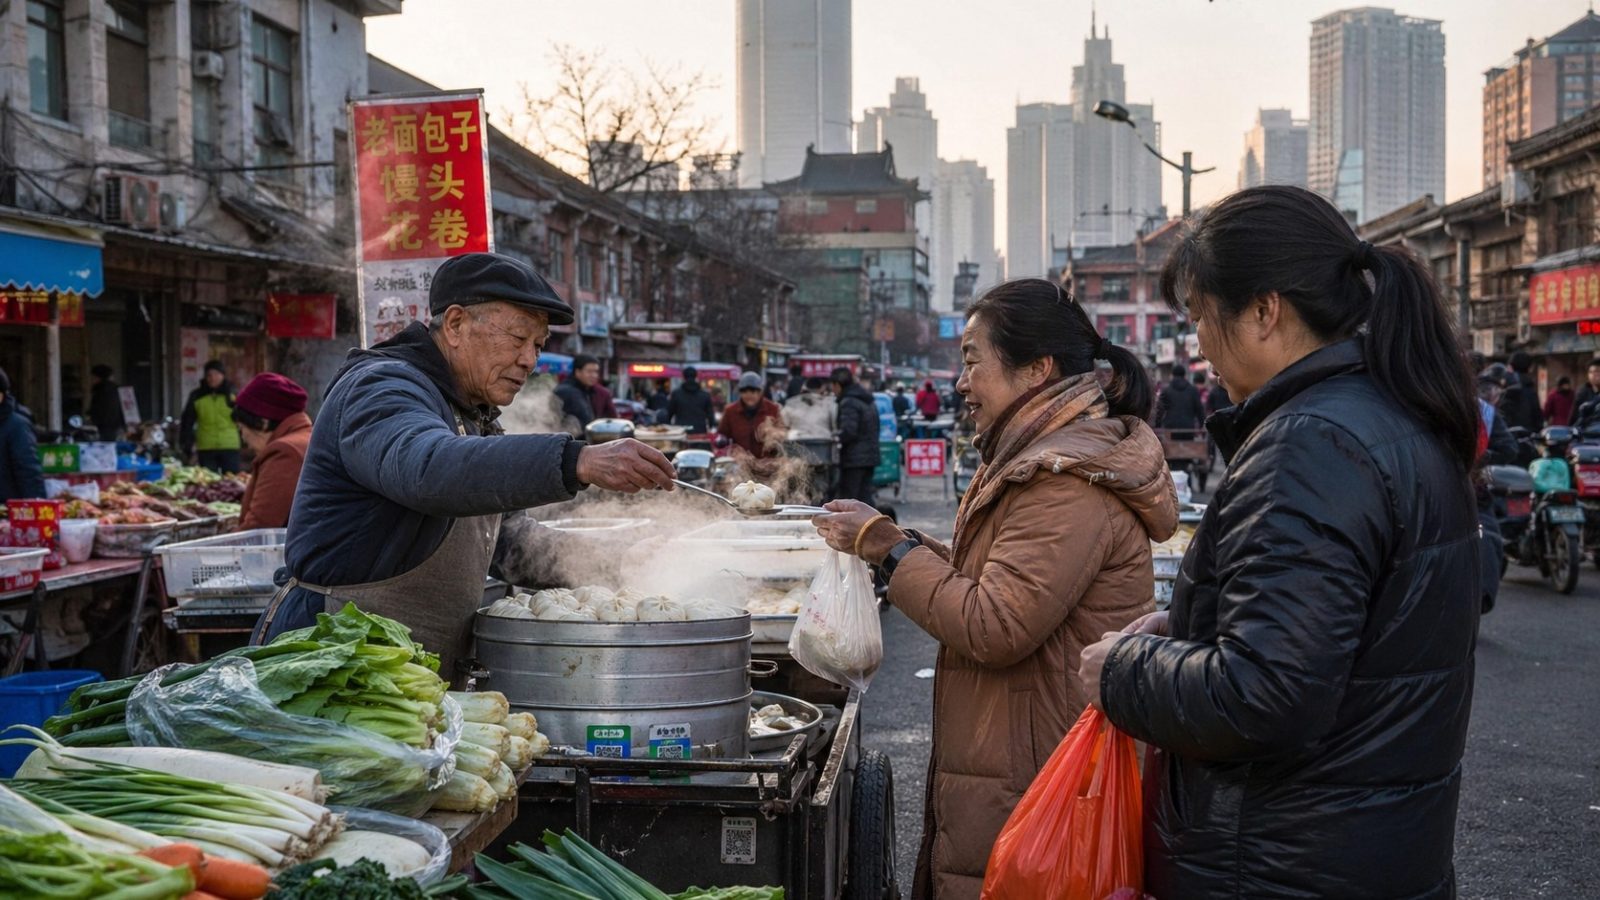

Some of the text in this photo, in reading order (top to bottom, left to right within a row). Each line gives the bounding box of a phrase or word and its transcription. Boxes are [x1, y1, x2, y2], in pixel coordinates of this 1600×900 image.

[361, 111, 477, 157] 老面包子
[382, 208, 469, 251] 花卷
